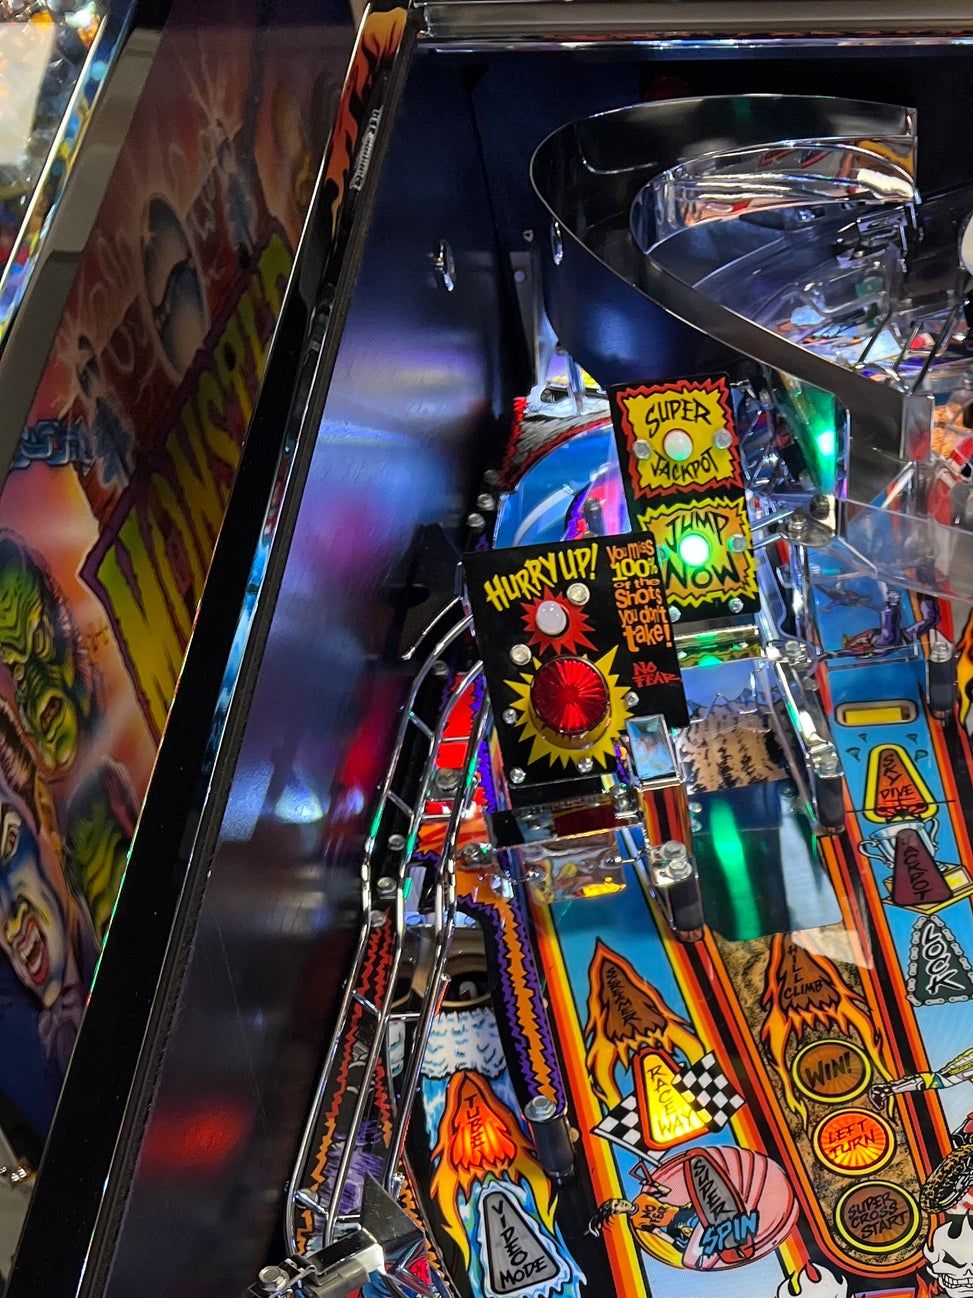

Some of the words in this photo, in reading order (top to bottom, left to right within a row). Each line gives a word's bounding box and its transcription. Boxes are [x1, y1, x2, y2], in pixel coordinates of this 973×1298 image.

[645, 397, 712, 438] SUPER
[651, 447, 719, 482] JACKPOT
[665, 510, 729, 554] JUMP
[483, 552, 557, 611] HURRY
[558, 543, 598, 580] UP!
[611, 558, 658, 581] 100%
[613, 580, 632, 590] of
[634, 577, 661, 587] the
[665, 550, 740, 590] NOW
[623, 624, 673, 653] take!
[632, 661, 657, 675] NO
[632, 672, 681, 688] FEAR
[883, 754, 903, 786] SKY
[880, 783, 915, 800] DIVE
[922, 923, 966, 995] LOCK
[783, 982, 823, 1000] CLIMB
[805, 1051, 851, 1089] WIN!
[647, 1065, 676, 1116] RACE
[464, 1095, 485, 1150] TUBE
[658, 1111, 693, 1136] WAY
[827, 1119, 869, 1143] LEFT
[830, 1130, 876, 1161] TURN
[847, 1192, 893, 1216] SUPER
[849, 1204, 903, 1229] CROSS
[492, 1203, 528, 1265] VIDEO
[701, 1211, 758, 1257] SPIN
[860, 1215, 909, 1240] START
[500, 1260, 549, 1289] MODE
